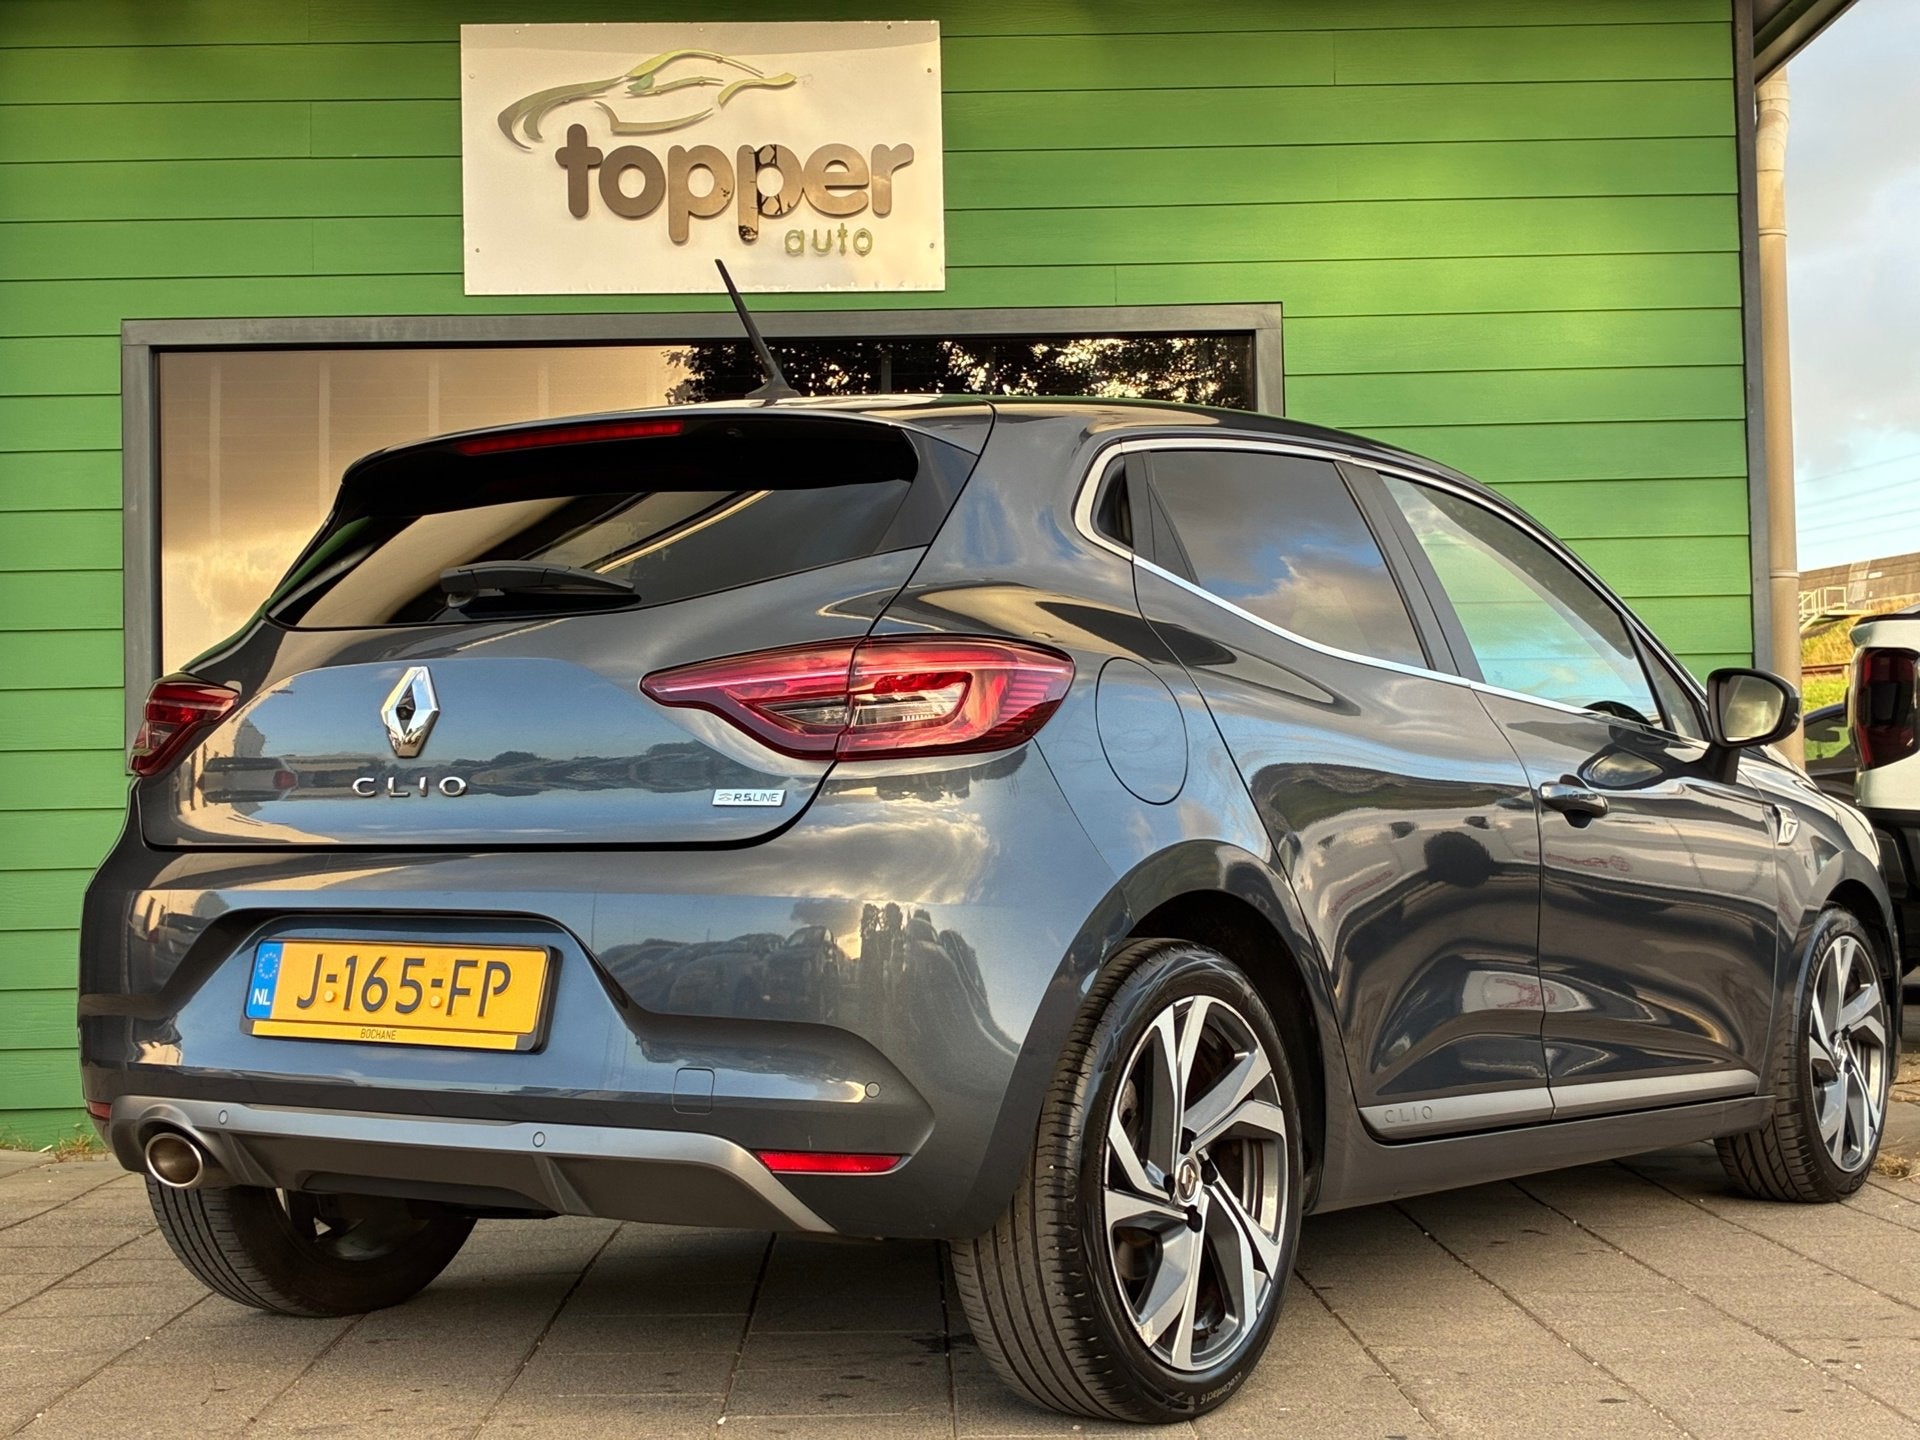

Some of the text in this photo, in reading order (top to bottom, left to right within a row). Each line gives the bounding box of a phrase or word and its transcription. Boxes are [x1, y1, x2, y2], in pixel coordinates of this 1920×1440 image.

[555, 123, 914, 244] topper
[784, 222, 873, 256] auto
[352, 776, 467, 797] CLIO
[296, 953, 511, 1017] J-165-FP
[252, 988, 271, 1006] NL
[360, 1028, 397, 1041] BOCHANE
[1384, 1105, 1433, 1124] CLIO
